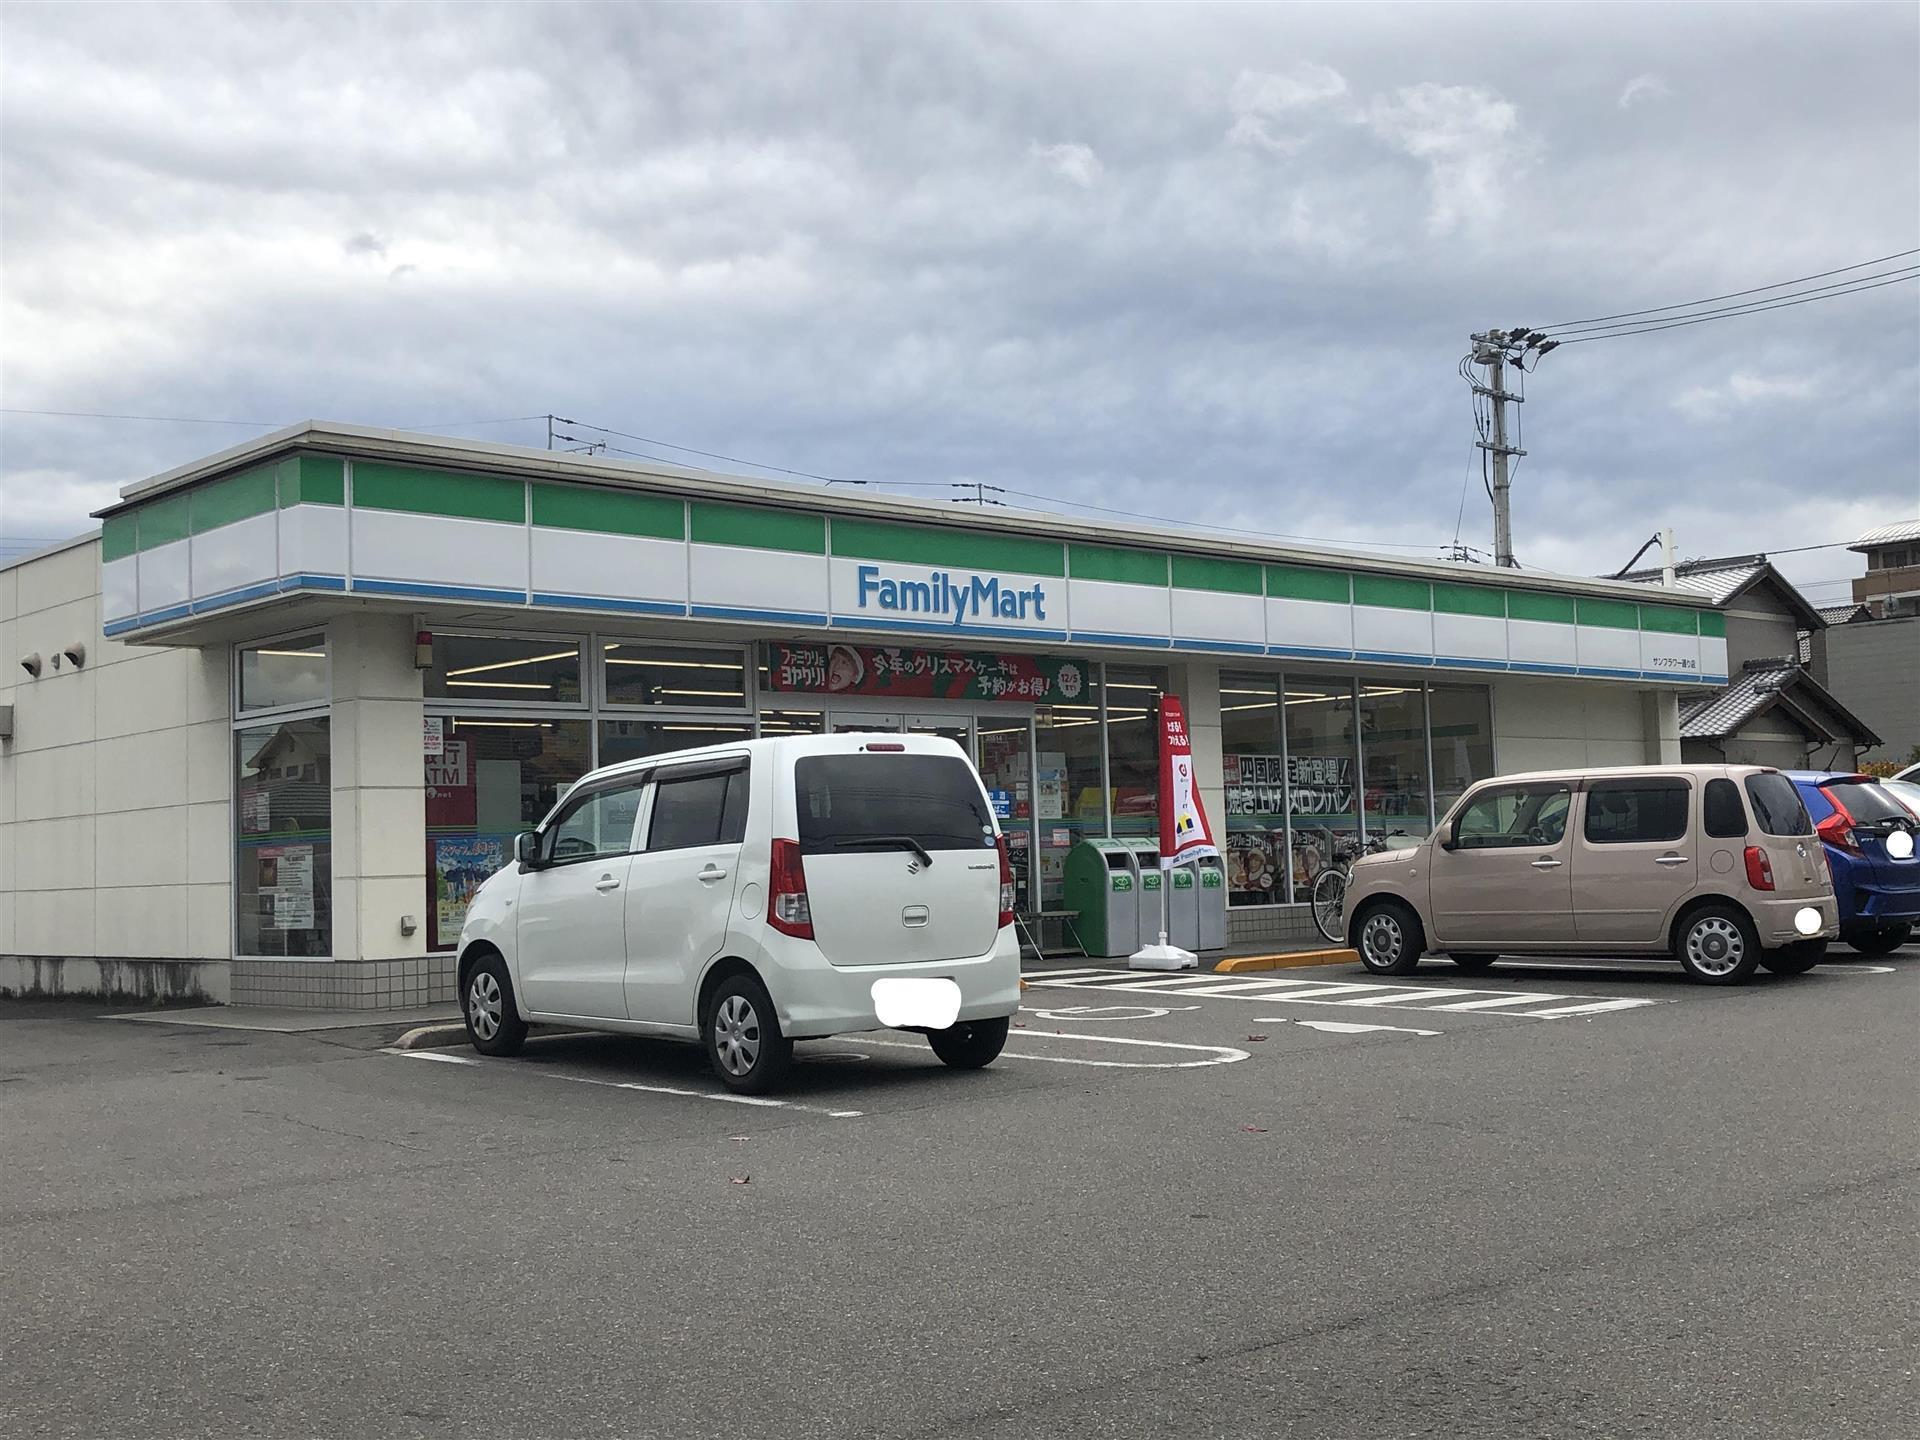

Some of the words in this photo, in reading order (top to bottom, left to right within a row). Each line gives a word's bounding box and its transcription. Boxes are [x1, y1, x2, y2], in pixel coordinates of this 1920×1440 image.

[857, 565, 1046, 626] FamilyMart
[781, 648, 825, 666] ファミクリと
[872, 654, 1018, 676] 今年のクリスマスケーキは
[977, 676, 1051, 697] 予約がお得!
[1060, 673, 1079, 684] 12/5
[1241, 758, 1349, 785] 四国限定新登場!
[1228, 787, 1352, 815] 焼き上げメロンパン
